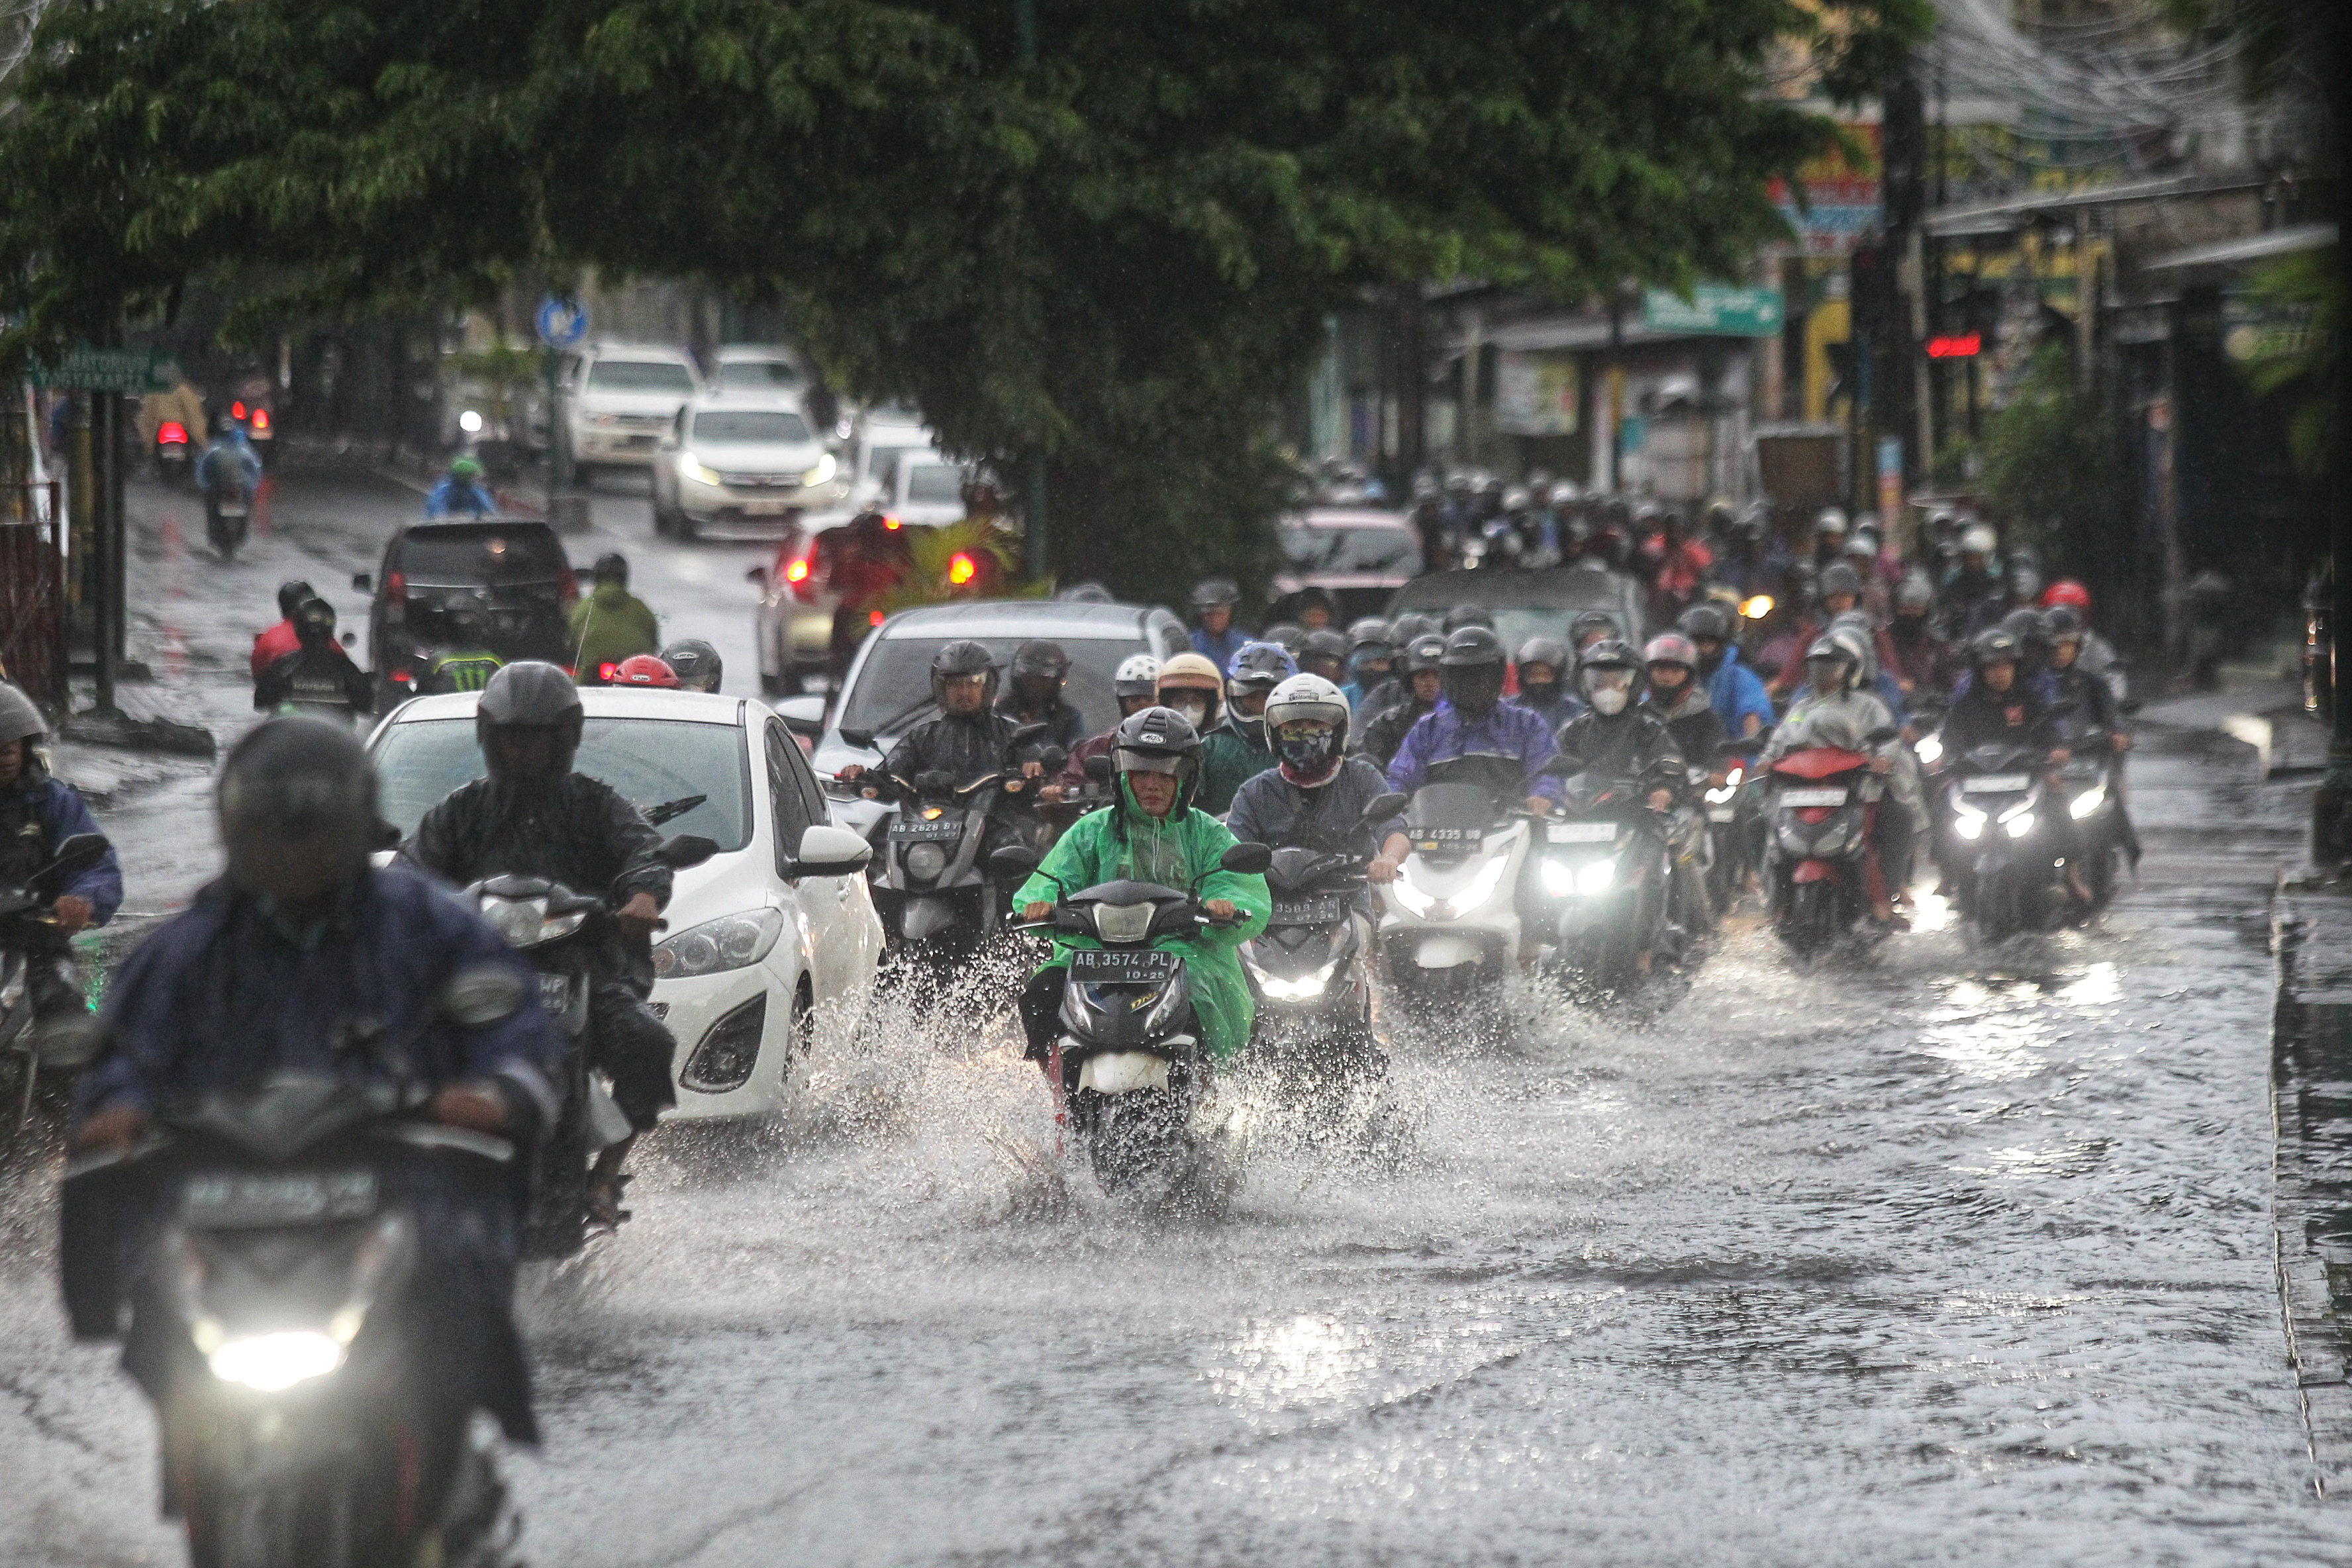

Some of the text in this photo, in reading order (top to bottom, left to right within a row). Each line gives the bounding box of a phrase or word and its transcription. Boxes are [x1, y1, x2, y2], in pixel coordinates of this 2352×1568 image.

[1076, 953, 1168, 966] AB 3574 PL
